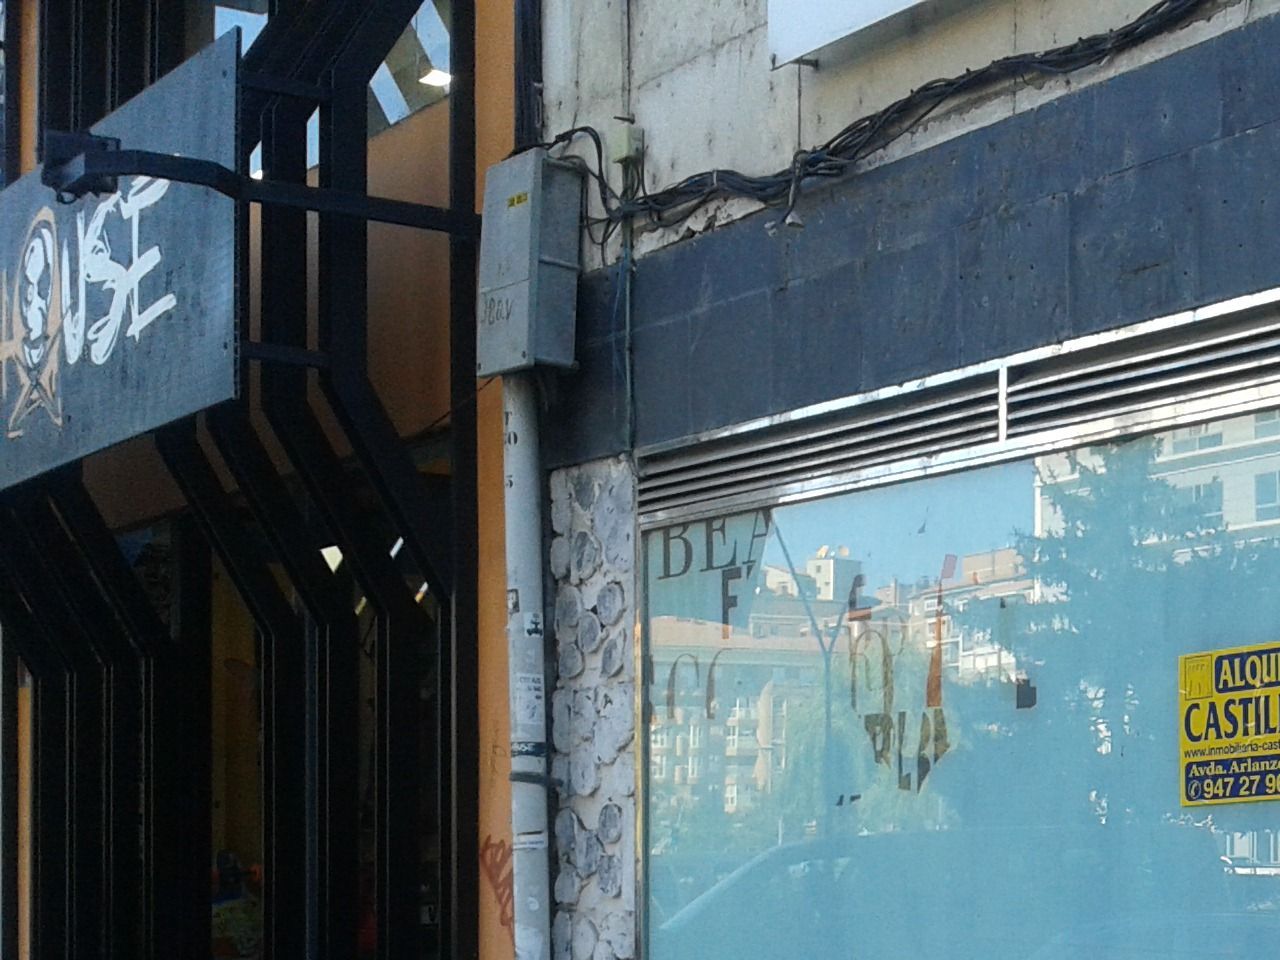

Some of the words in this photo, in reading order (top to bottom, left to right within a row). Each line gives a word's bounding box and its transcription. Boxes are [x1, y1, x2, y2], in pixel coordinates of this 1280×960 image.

[1188, 761, 1227, 777] Avda.
[1203, 776, 1235, 799] 947
[1239, 774, 1261, 796] 27
